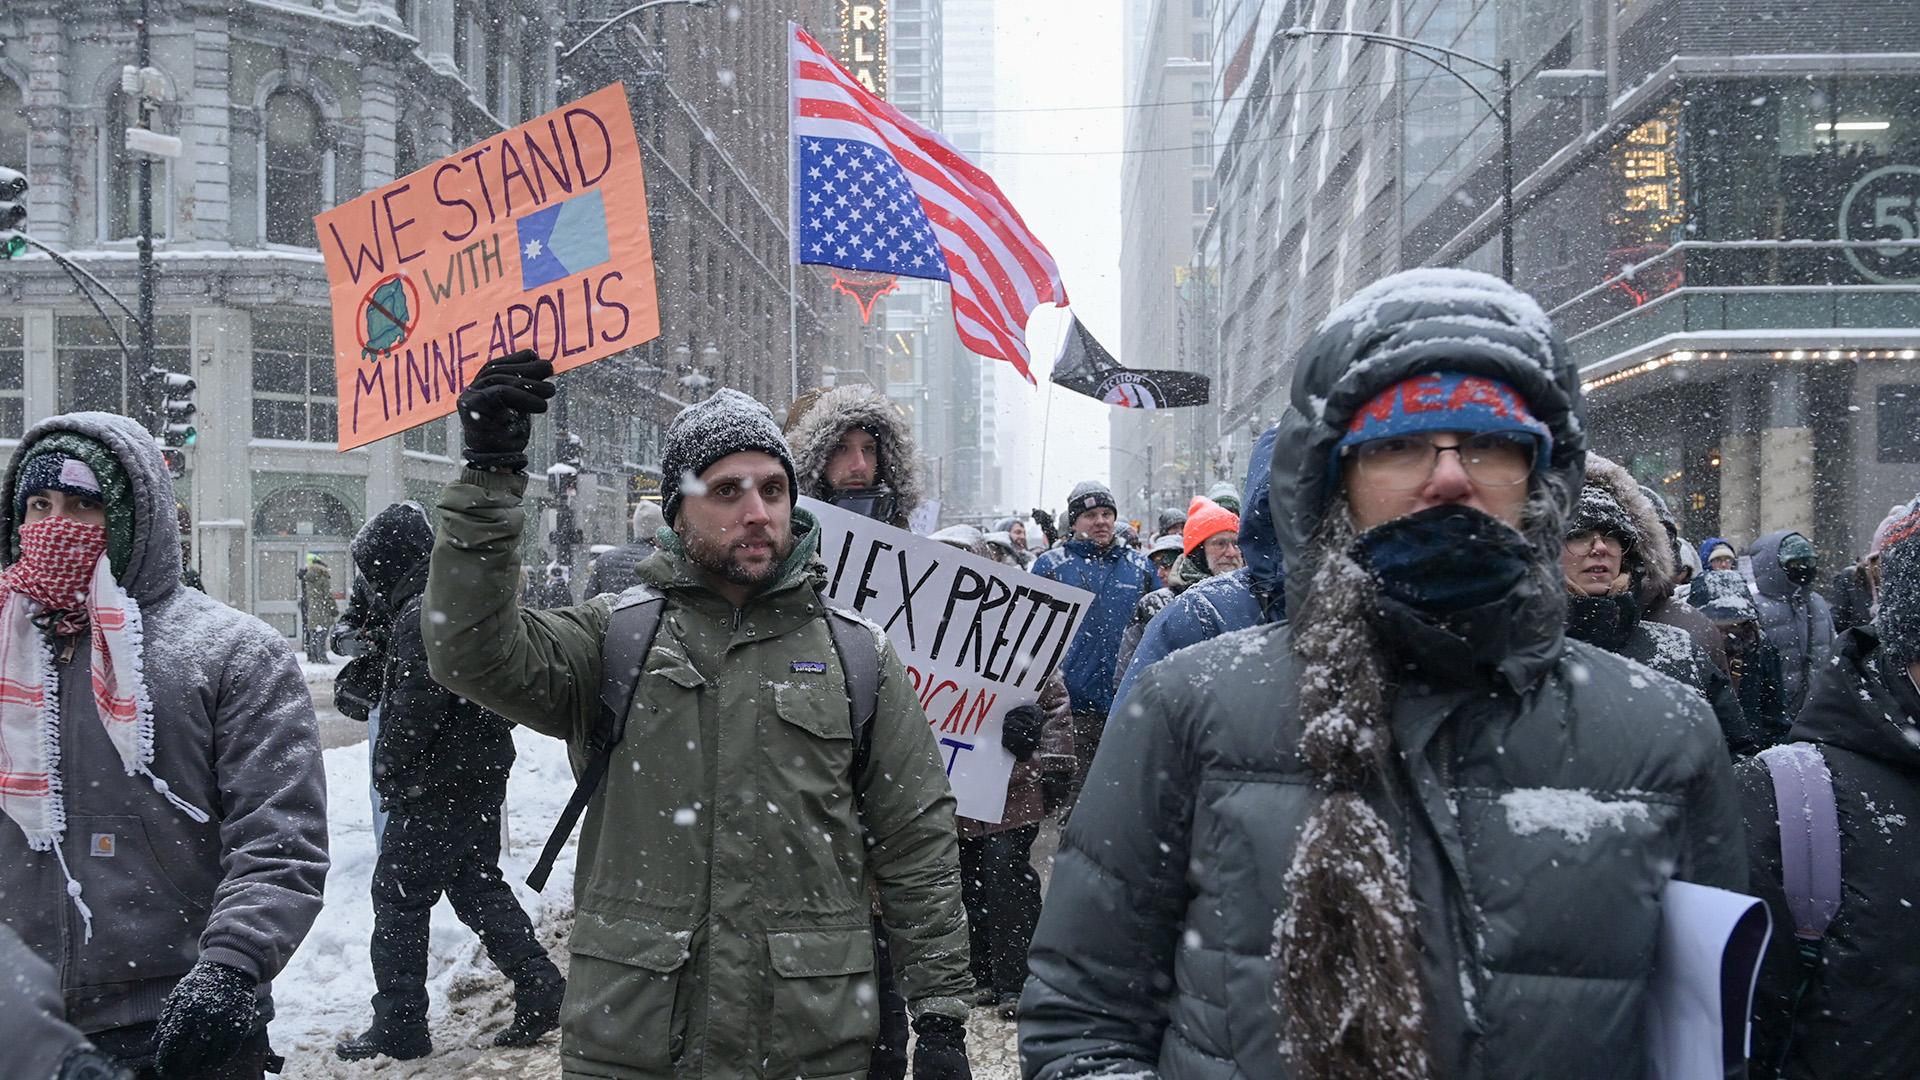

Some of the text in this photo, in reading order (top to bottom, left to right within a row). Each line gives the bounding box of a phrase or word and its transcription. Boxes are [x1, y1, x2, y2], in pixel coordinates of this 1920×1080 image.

[329, 108, 612, 284] WE STAND
[1875, 197, 1920, 256] 5
[423, 233, 504, 304] WITH
[353, 271, 630, 434] MINNEAPOLIS
[930, 565, 1081, 692] PRETTI
